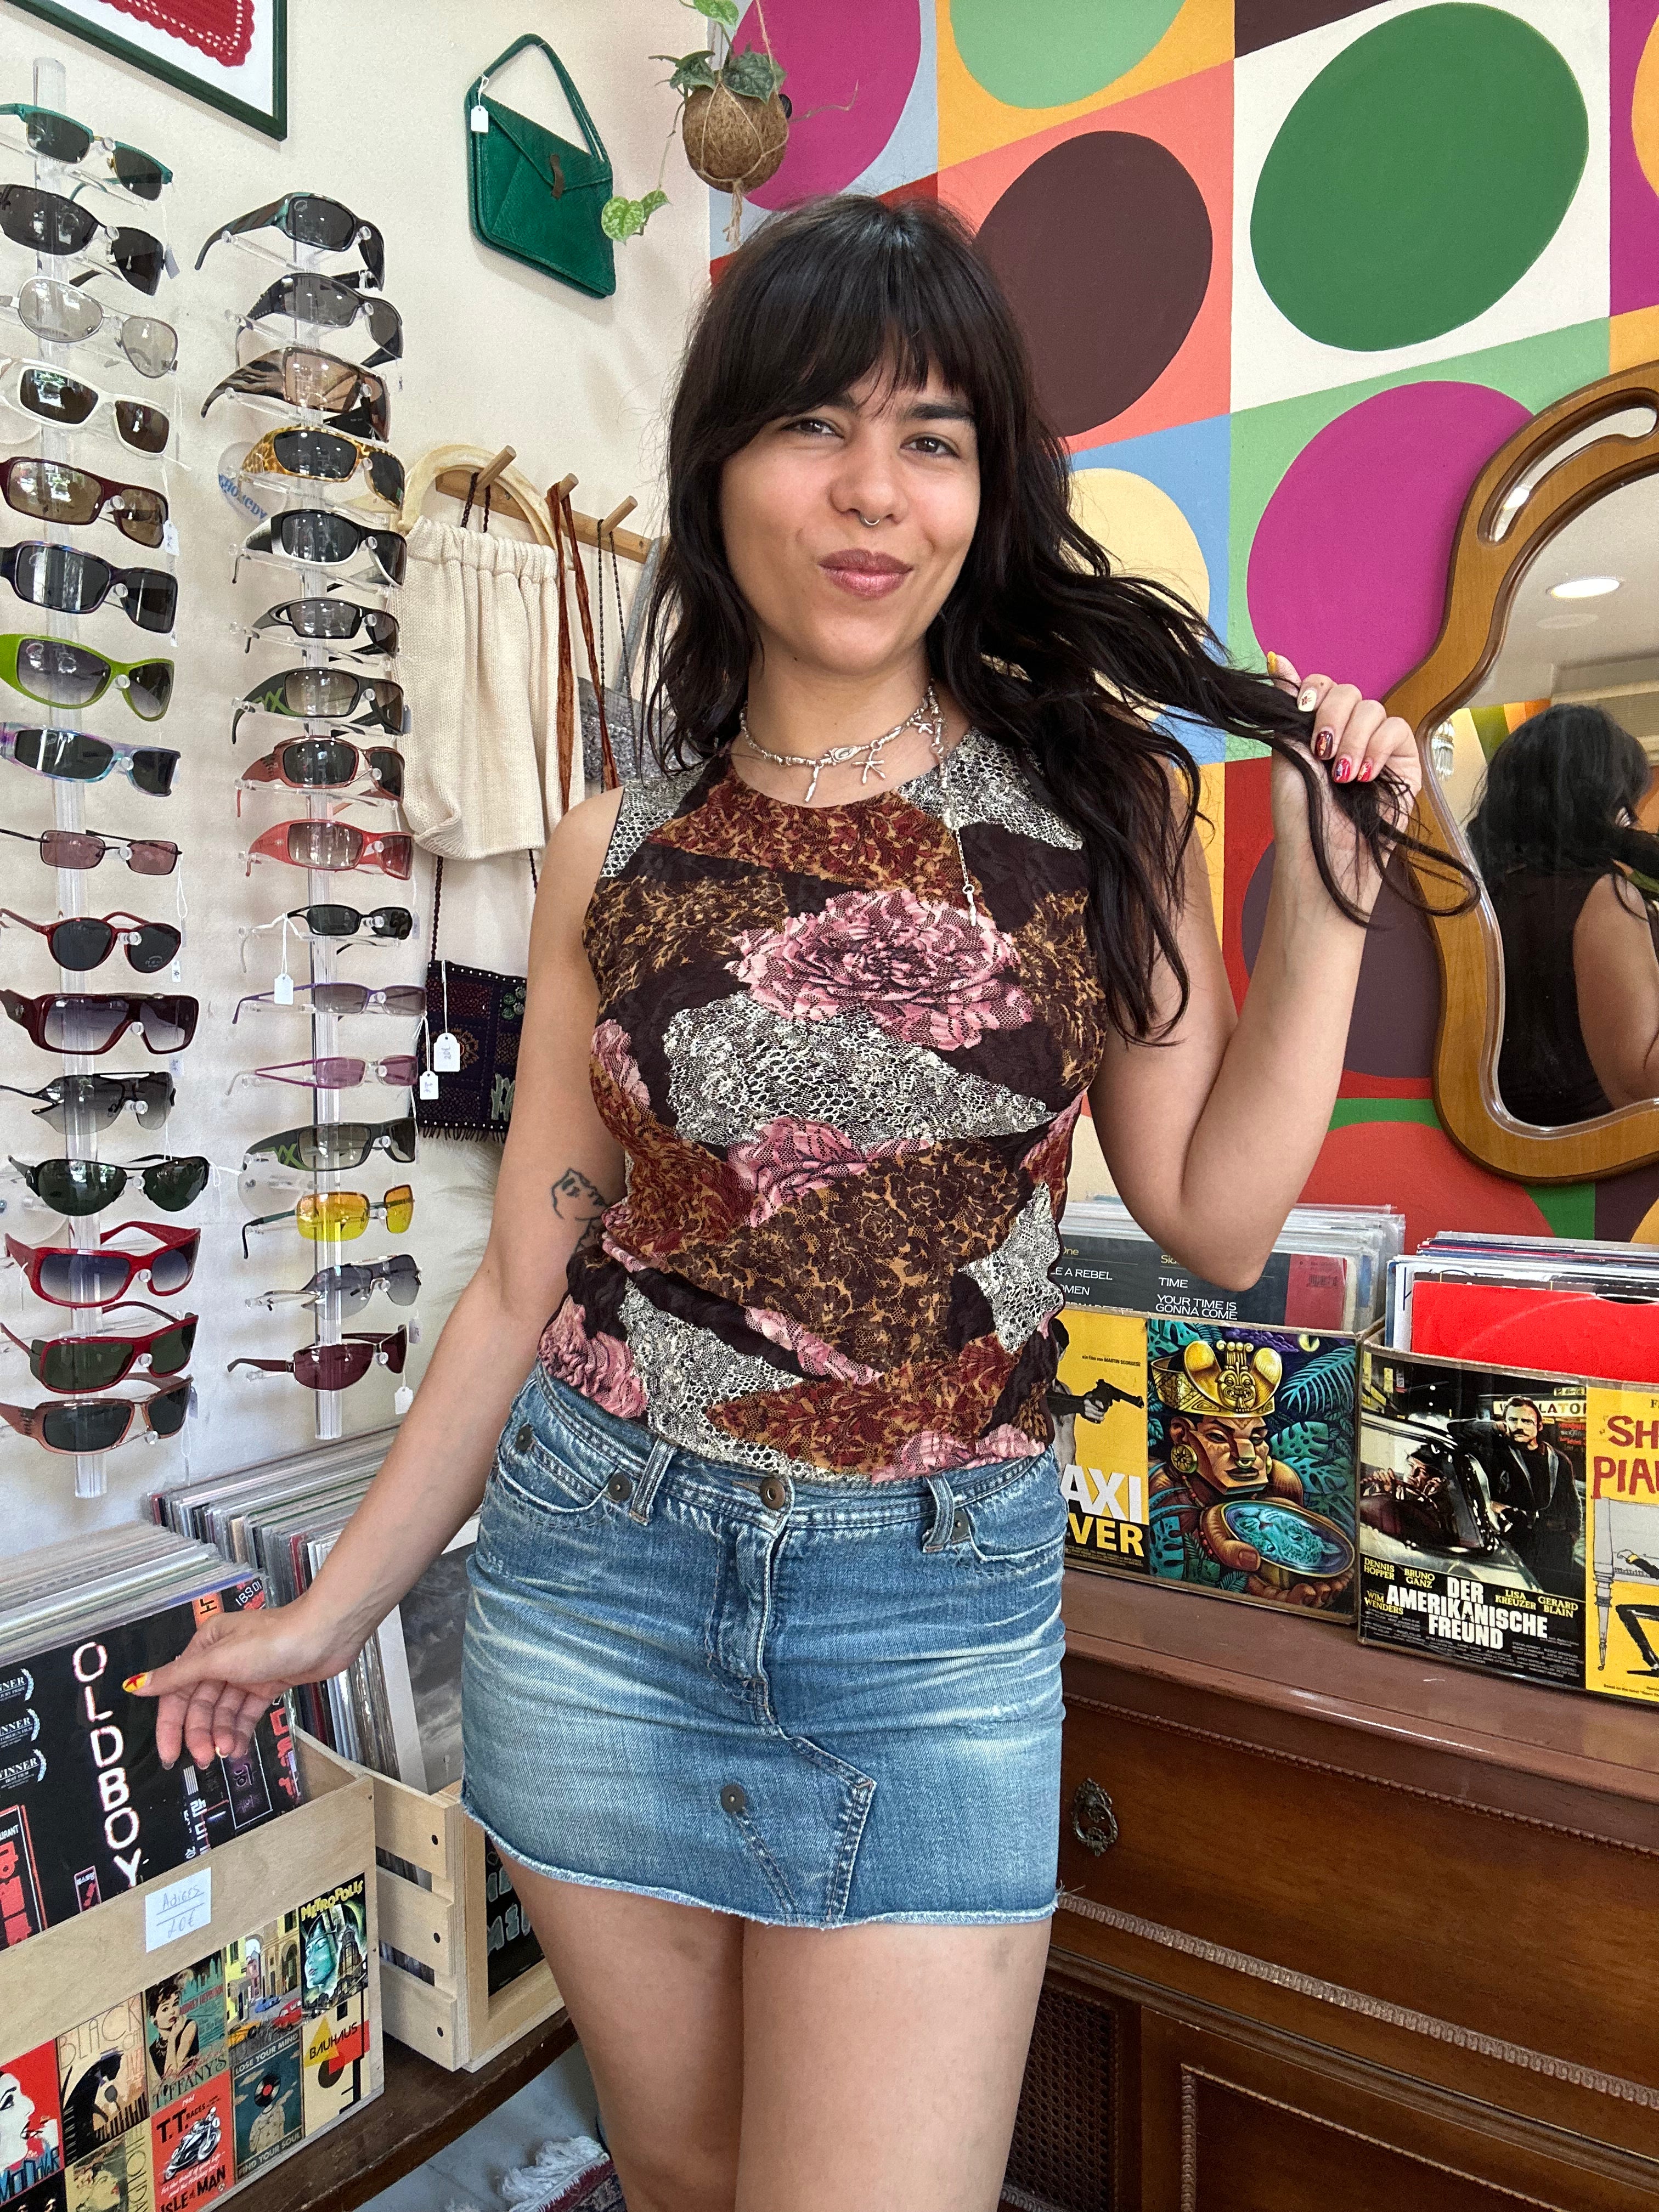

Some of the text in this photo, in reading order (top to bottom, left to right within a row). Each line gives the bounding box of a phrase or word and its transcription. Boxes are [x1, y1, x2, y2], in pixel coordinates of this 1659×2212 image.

[1064, 1268, 1073, 1277] A
[1075, 1269, 1113, 1280] REBEL
[1158, 1277, 1189, 1289] TIME
[1156, 1294, 1237, 1311] YOUR TIME IS
[1155, 1303, 1238, 1321] GONNA COME
[1069, 1512, 1144, 1558] VER
[1364, 1557, 1395, 1573] DENNIS
[1364, 1565, 1395, 1581] HOPPER
[1404, 1568, 1435, 1582] BRUNO
[1406, 1577, 1432, 1589] GANZ
[1366, 1590, 1385, 1603] WIM
[1447, 1576, 1484, 1604] DER
[1505, 1589, 1527, 1601] LISA
[1364, 1597, 1404, 1615] WENDERS
[1386, 1584, 1548, 1639] AMERIKANISCHE
[1495, 1595, 1537, 1610] KREUZER
[1538, 1596, 1579, 1611] GERARD
[1543, 1605, 1574, 1618] BLAIN
[1429, 1613, 1503, 1650] FREUND
[0, 1717, 31, 1735] NNER
[72, 1641, 142, 1888] OLDBOY
[301, 1880, 364, 1922] METROPOLIS
[58, 1996, 142, 2070] BLACK
[309, 2021, 357, 2060] BAUHAUS
[235, 2033, 298, 2075] LOSE YOUR MIND
[186, 2102, 206, 2120] RACES
[238, 2132, 301, 2176] FIND YOUR SOUL
[197, 2165, 225, 2197] MAN
